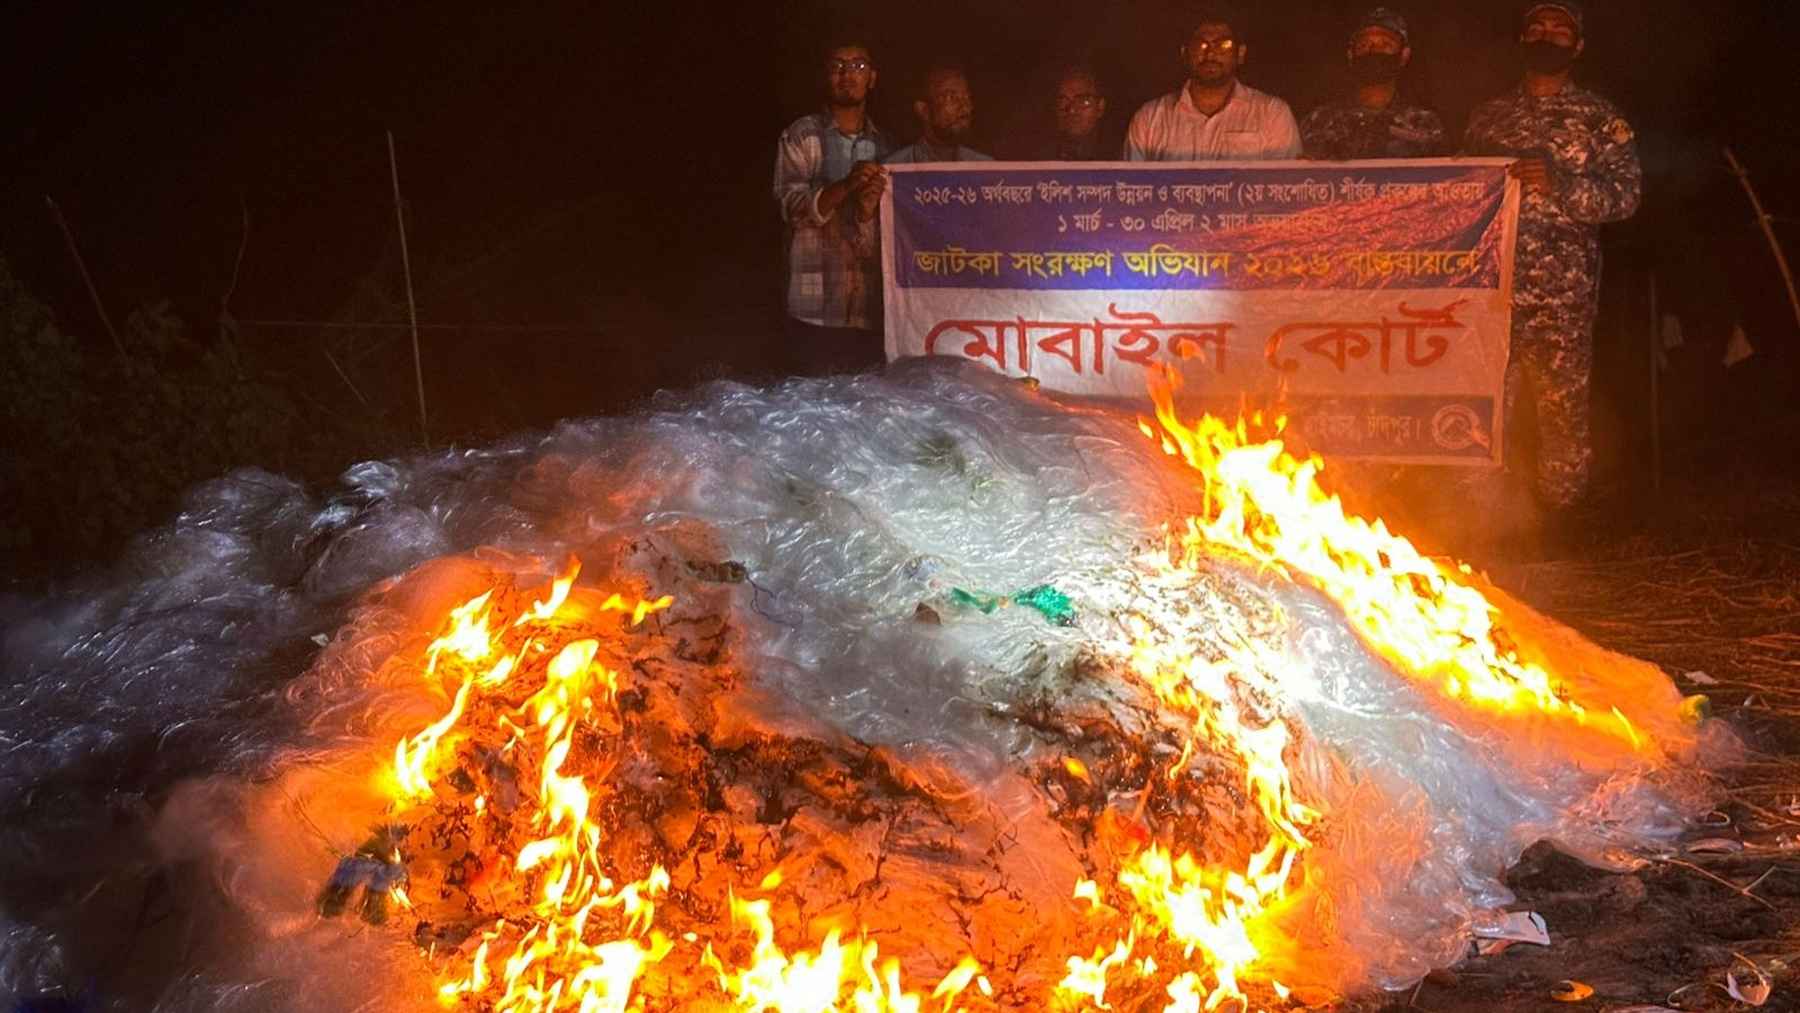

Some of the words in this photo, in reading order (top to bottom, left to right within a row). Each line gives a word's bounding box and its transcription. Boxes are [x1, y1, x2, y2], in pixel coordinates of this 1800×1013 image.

[914, 186, 977, 205] ২০২৫-২৬
[1077, 184, 1111, 202] সম্পদ
[1116, 181, 1152, 204] উন্নয়ন
[1158, 185, 1168, 201] ও
[1073, 208, 1102, 232] মার্চ
[1120, 216, 1145, 233] ৩০
[1151, 207, 1196, 233] এপ্রিল
[914, 246, 1001, 276] জাটকা
[1010, 251, 1113, 279] সংরক্ষণ
[1121, 243, 1230, 277] অভিযান
[924, 302, 1237, 375] মোবাইল
[1265, 298, 1472, 374] কোর্ট
